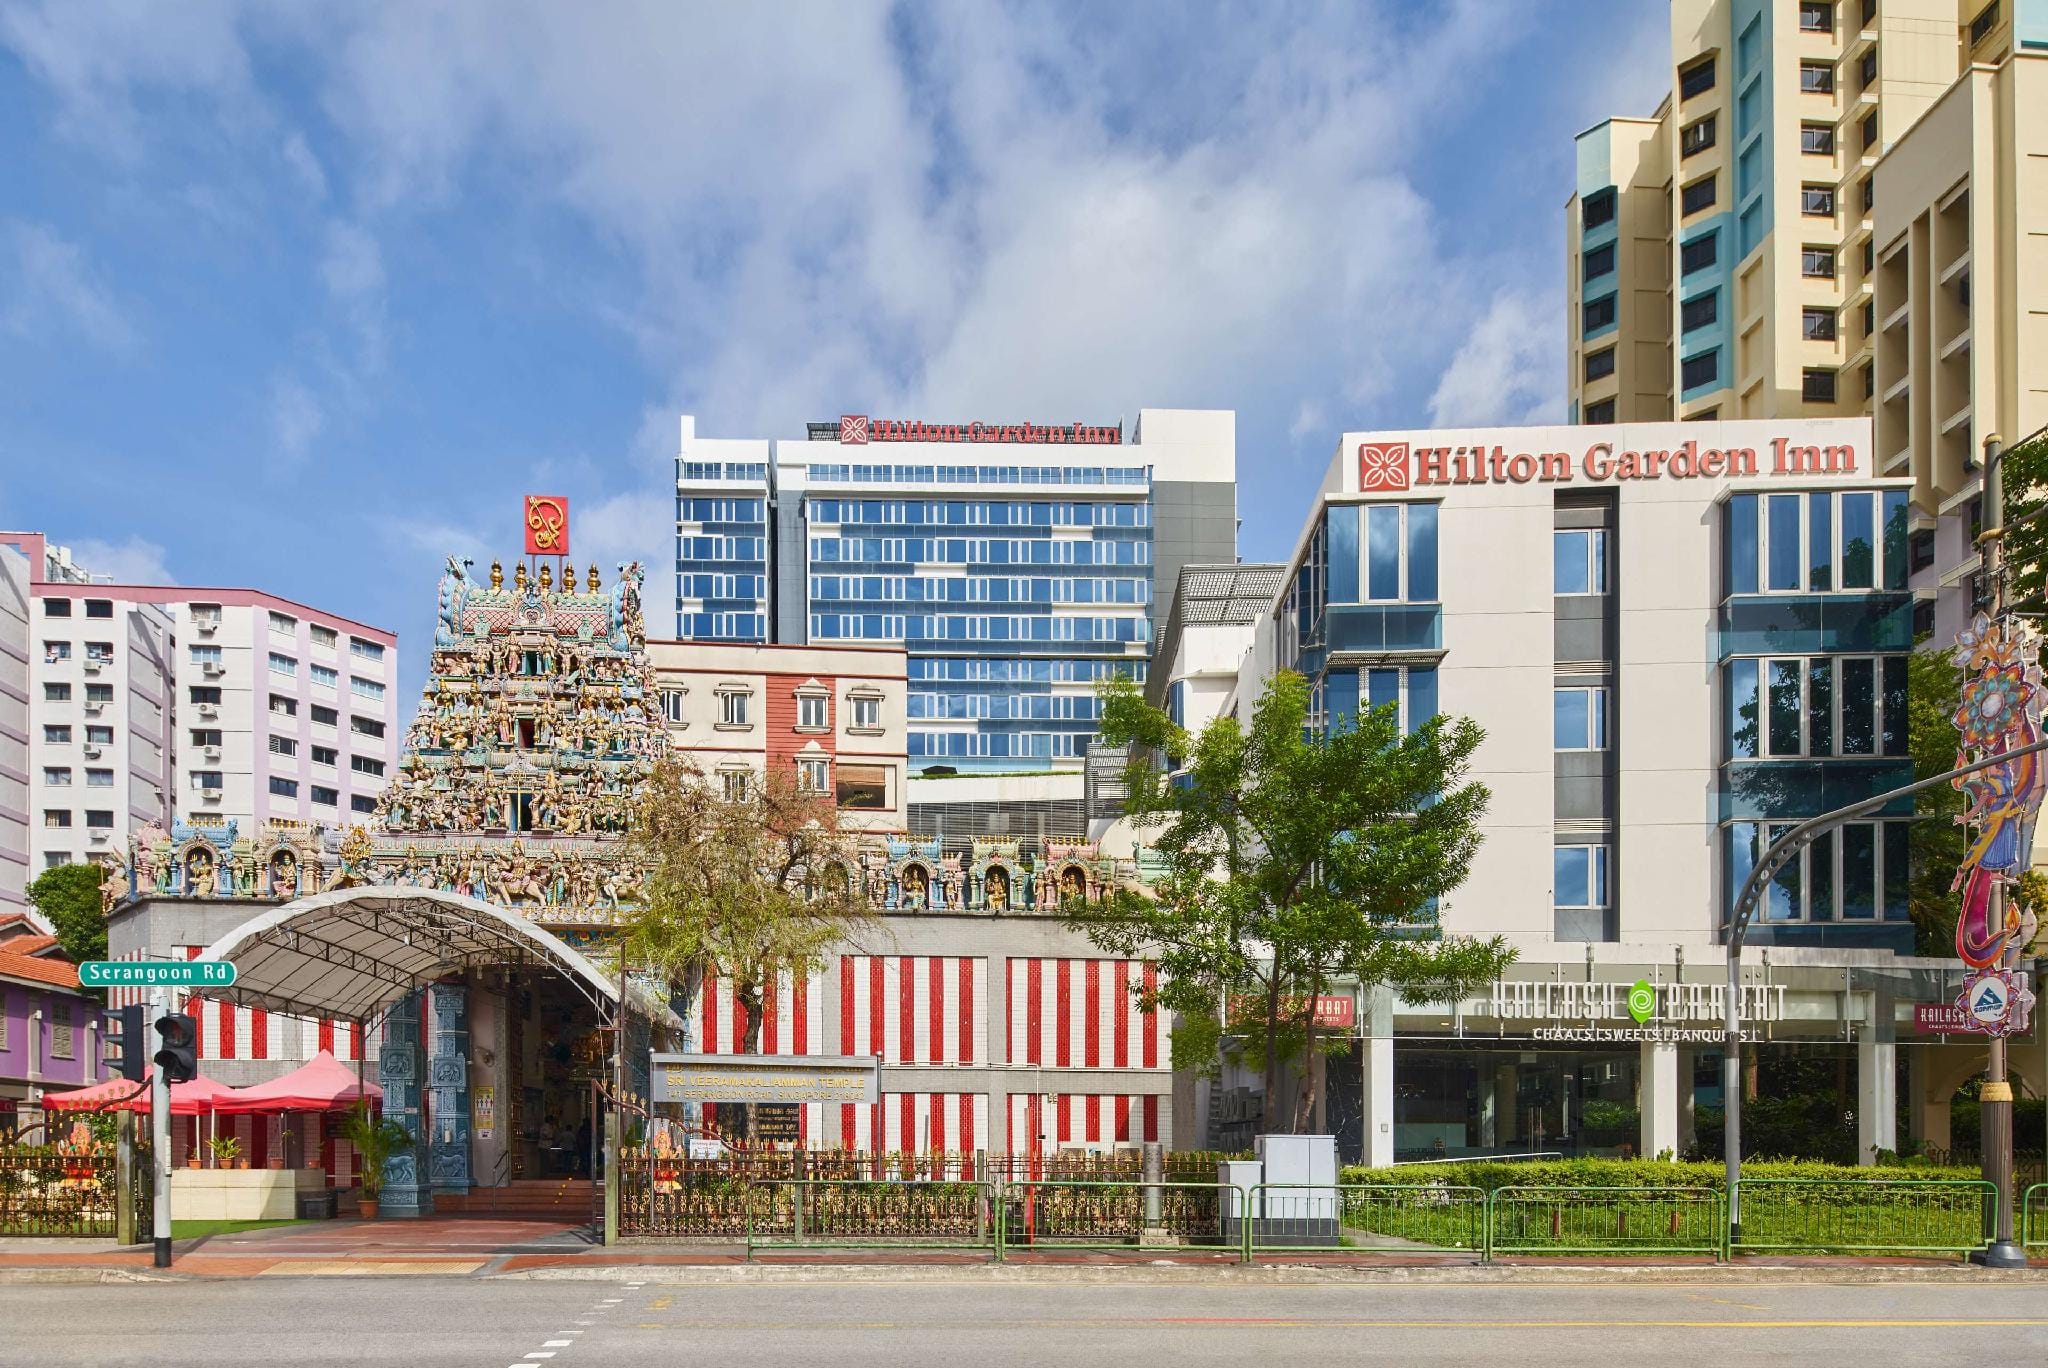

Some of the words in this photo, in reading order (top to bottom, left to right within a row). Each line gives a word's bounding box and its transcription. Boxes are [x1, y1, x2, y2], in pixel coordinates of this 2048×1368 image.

[873, 420, 962, 442] Hilton
[968, 421, 1064, 443] Garden
[1073, 422, 1121, 443] Inn
[1414, 447, 1574, 485] Hilton
[1583, 441, 1758, 480] Garden
[1769, 437, 1858, 473] Inn
[90, 964, 192, 983] Serangoon
[203, 964, 226, 979] Rd
[1490, 981, 1616, 1019] KAILASH
[1533, 1027, 1592, 1040] CHAATS
[1604, 1028, 1660, 1041] SWEETS
[1671, 1029, 1748, 1042] BANQUS
[666, 1075, 686, 1087] SRI
[818, 1077, 865, 1088] TEMPLE
[778, 1091, 831, 1101] SINGAPORE
